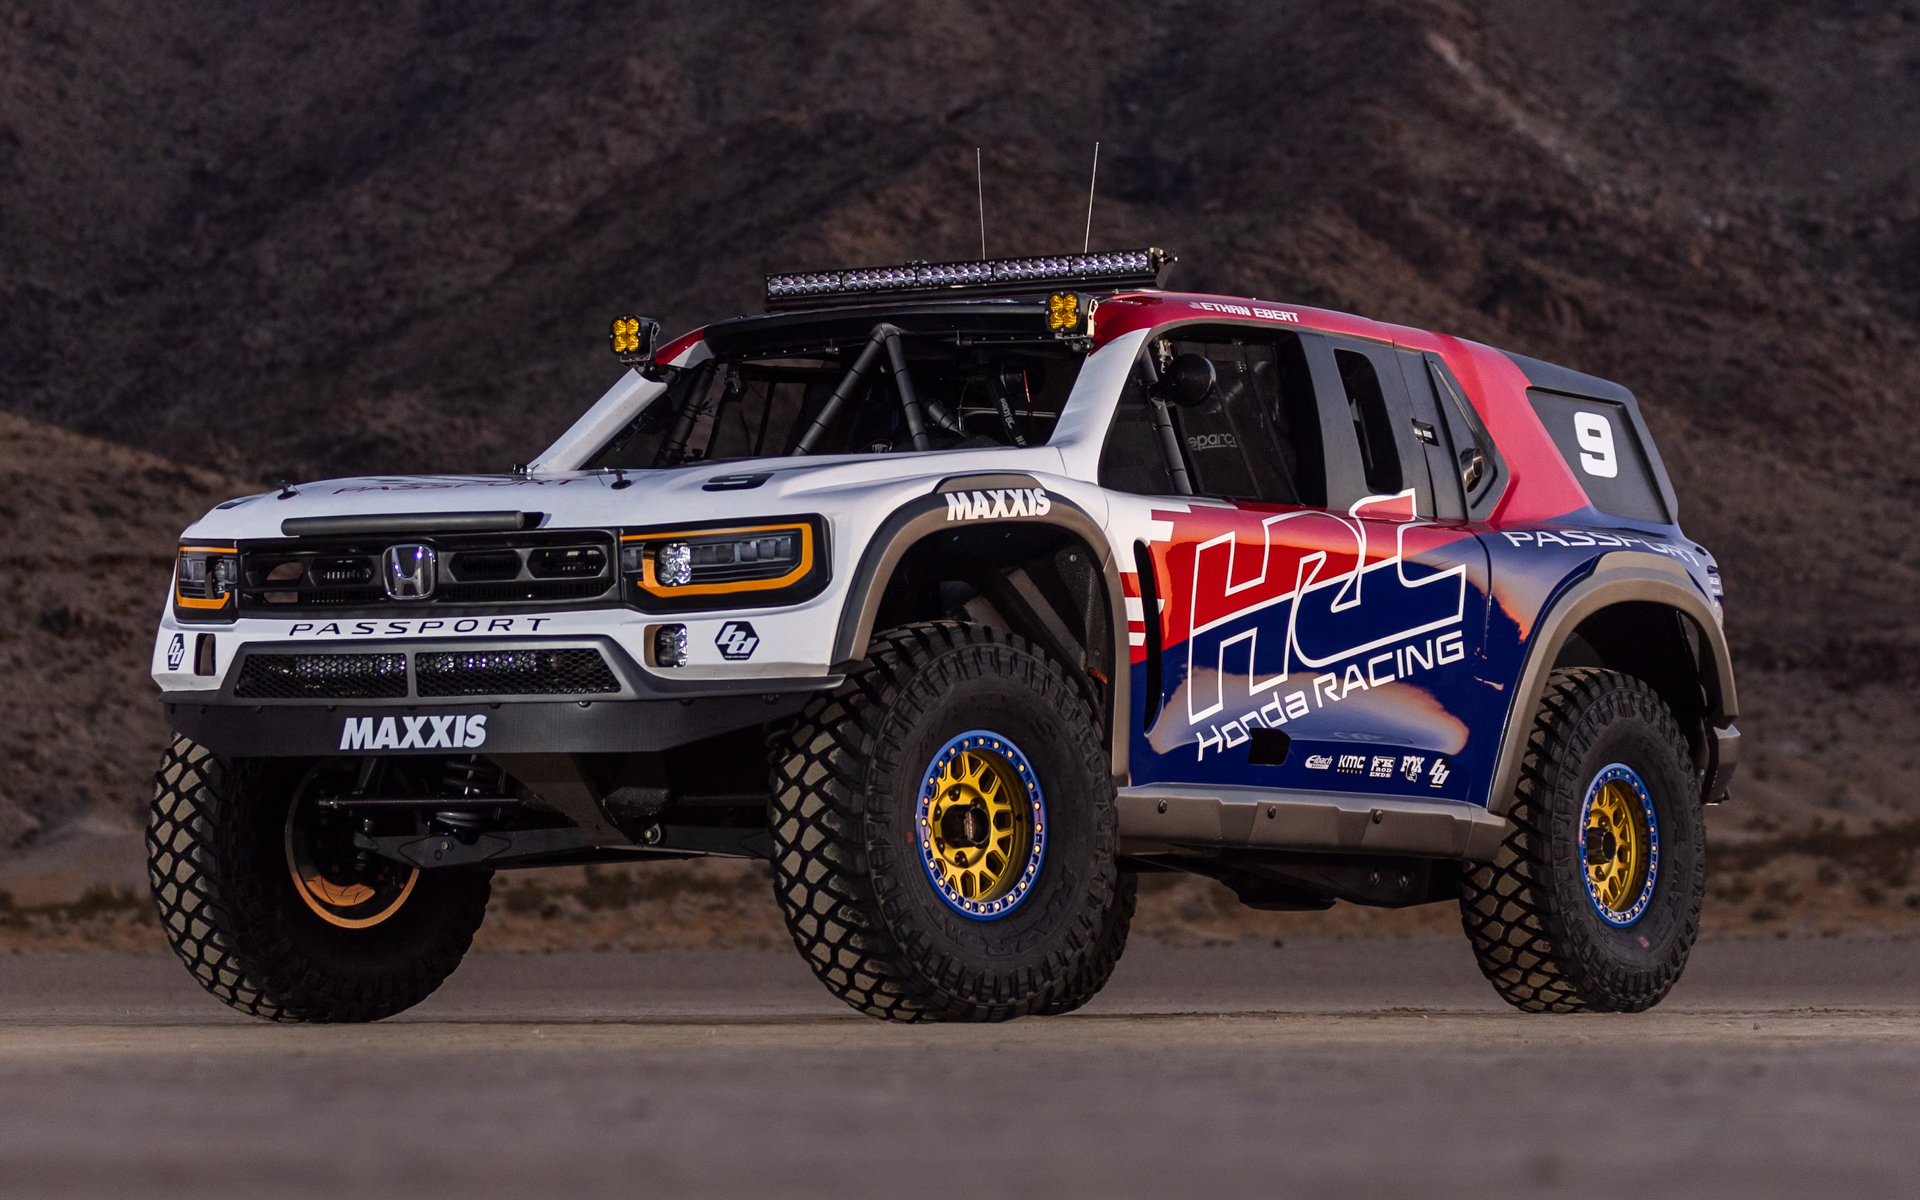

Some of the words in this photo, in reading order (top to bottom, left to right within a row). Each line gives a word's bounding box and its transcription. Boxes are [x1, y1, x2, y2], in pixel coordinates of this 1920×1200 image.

[1200, 302, 1251, 316] ETHAN
[1253, 307, 1299, 323] EBERT
[1574, 411, 1618, 478] 9
[944, 488, 1051, 521] MAXXIS
[1501, 530, 1701, 567] PASSPORT
[289, 618, 551, 636] PASSPORT
[1195, 690, 1310, 762] Honda
[1313, 630, 1466, 708] RACING
[340, 714, 488, 751] MAXXIS
[1305, 755, 1333, 768] Eibach
[1337, 754, 1366, 769] KMC
[1400, 755, 1425, 776] FOX
